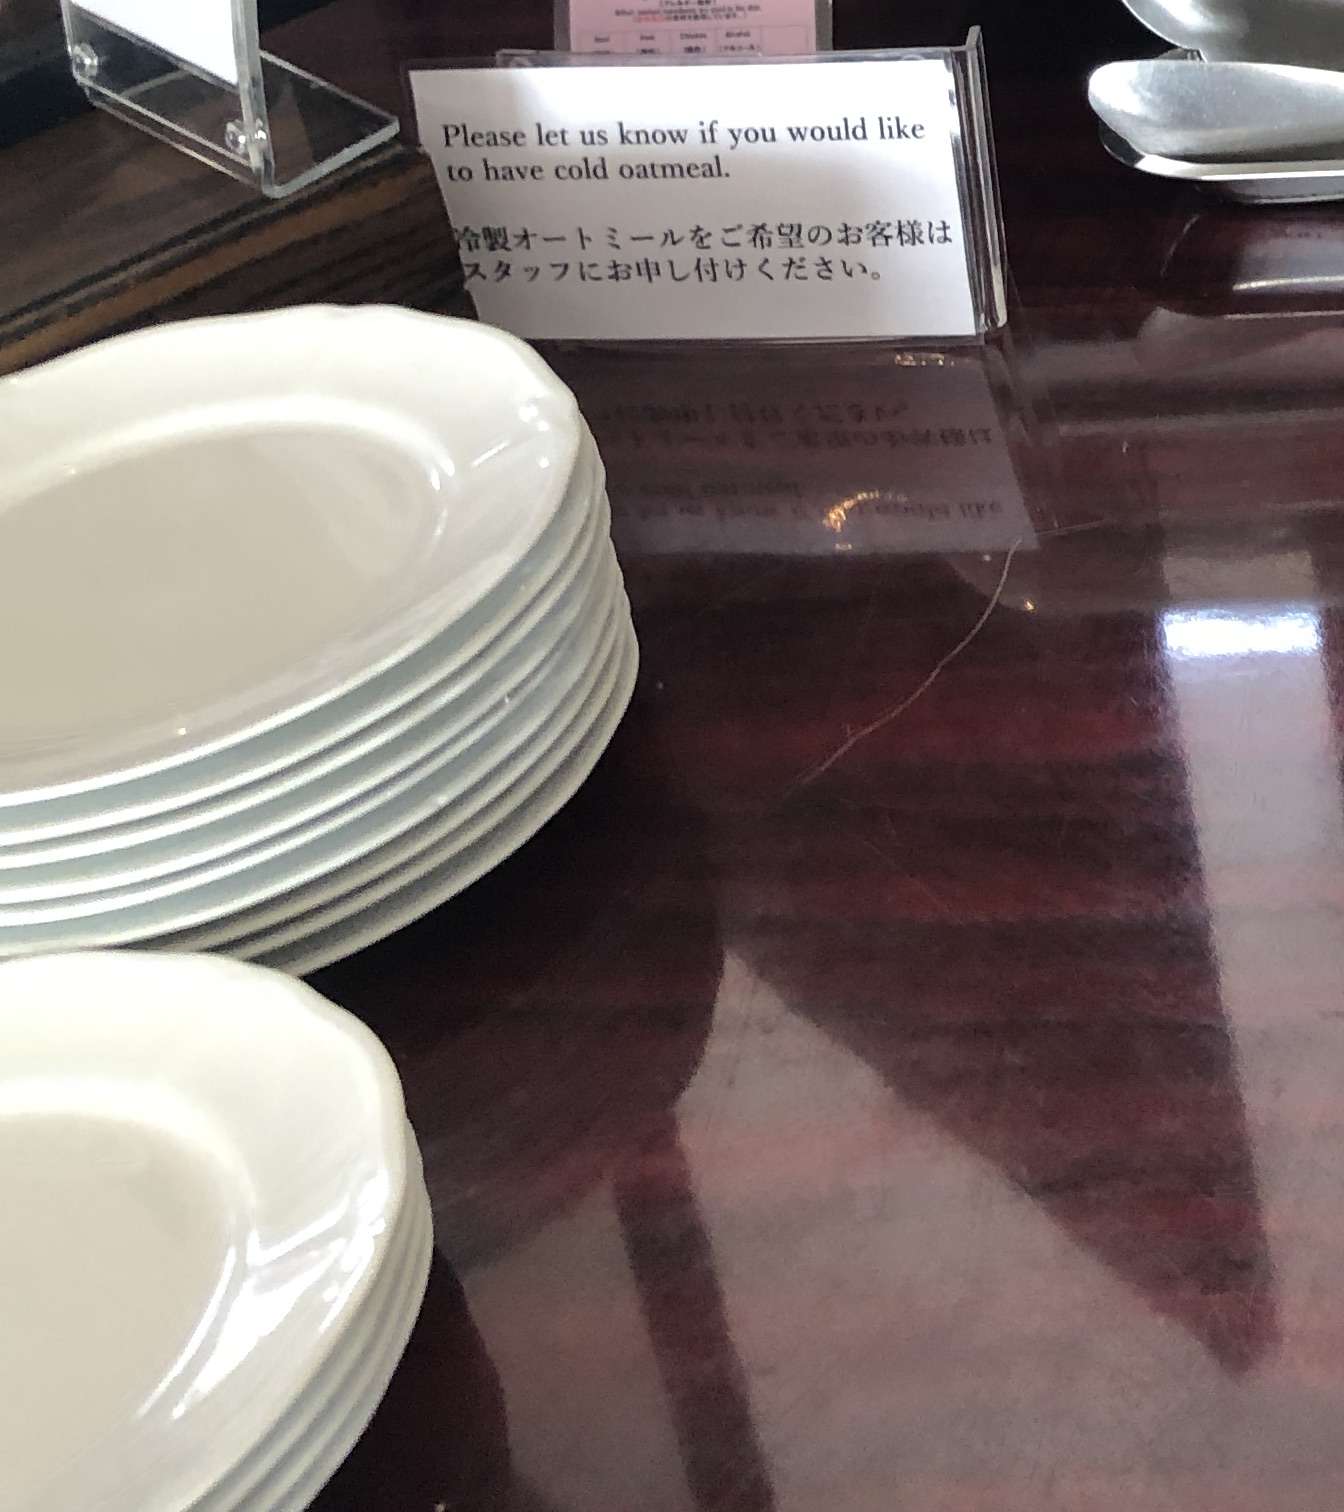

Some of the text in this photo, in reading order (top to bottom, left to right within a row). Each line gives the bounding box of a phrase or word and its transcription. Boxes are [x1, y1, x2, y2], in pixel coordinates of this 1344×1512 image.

[442, 116, 925, 150] Please let us know if you would like
[447, 154, 730, 182] to have cold oatmeal.
[453, 220, 952, 252] 冷製オートミールをご希望のお客様は
[463, 256, 880, 283] スタッフにお申し付けください。
